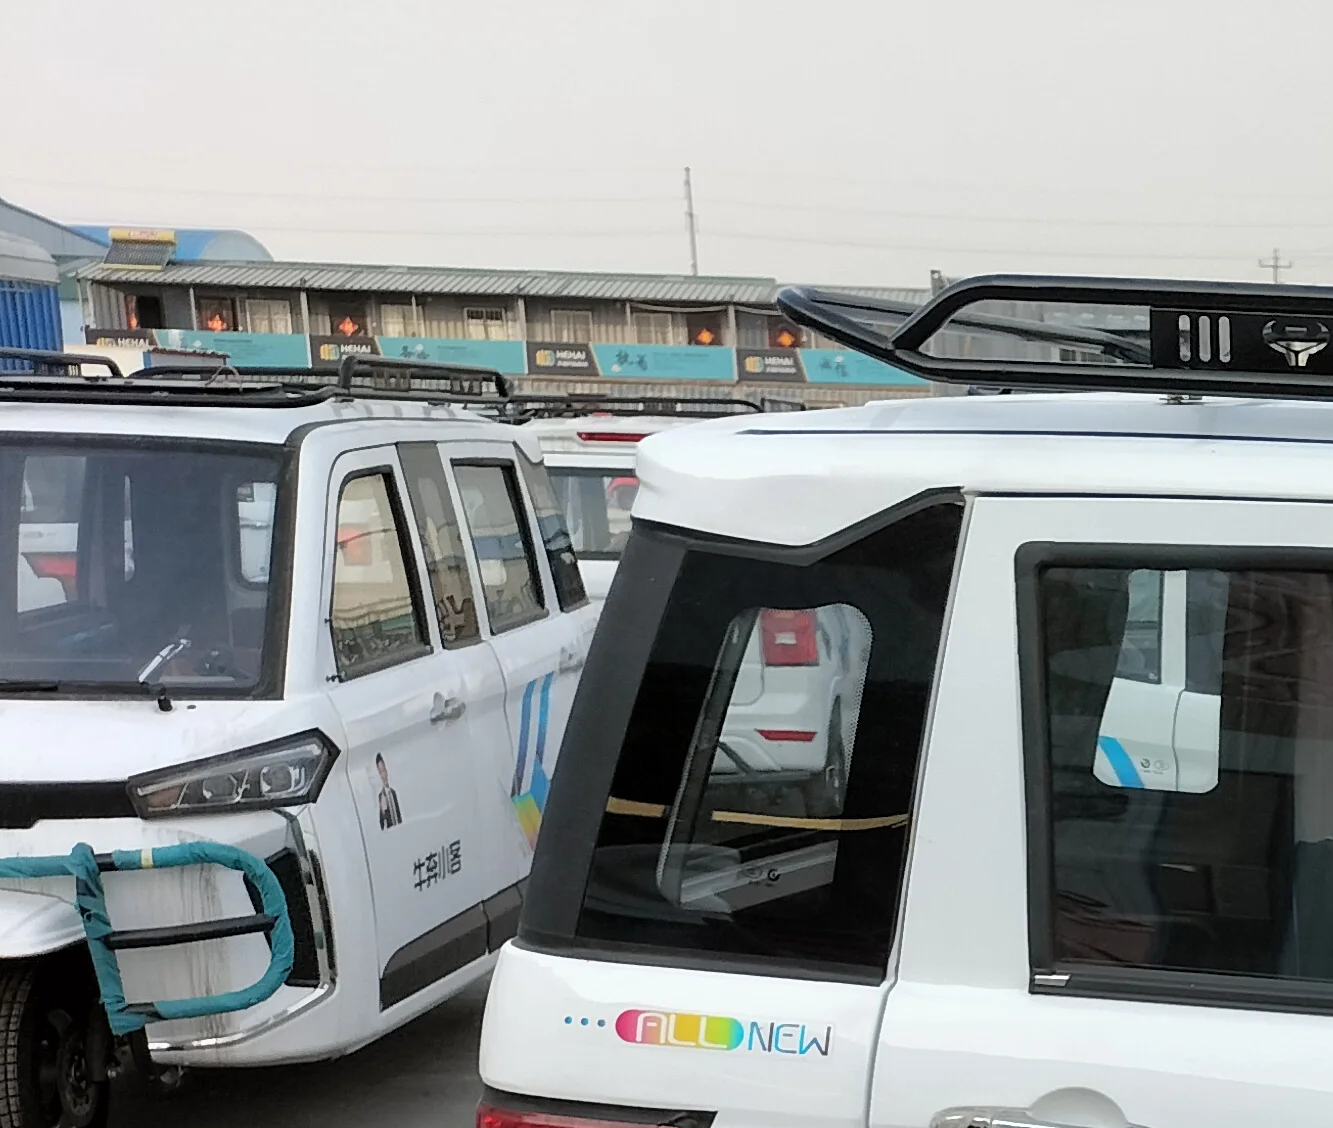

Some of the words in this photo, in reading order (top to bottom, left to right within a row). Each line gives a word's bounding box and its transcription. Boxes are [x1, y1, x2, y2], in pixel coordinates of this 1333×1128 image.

[413, 839, 462, 892] 牛奔小客
[635, 1011, 728, 1049] ALL
[747, 1021, 832, 1056] NEW
